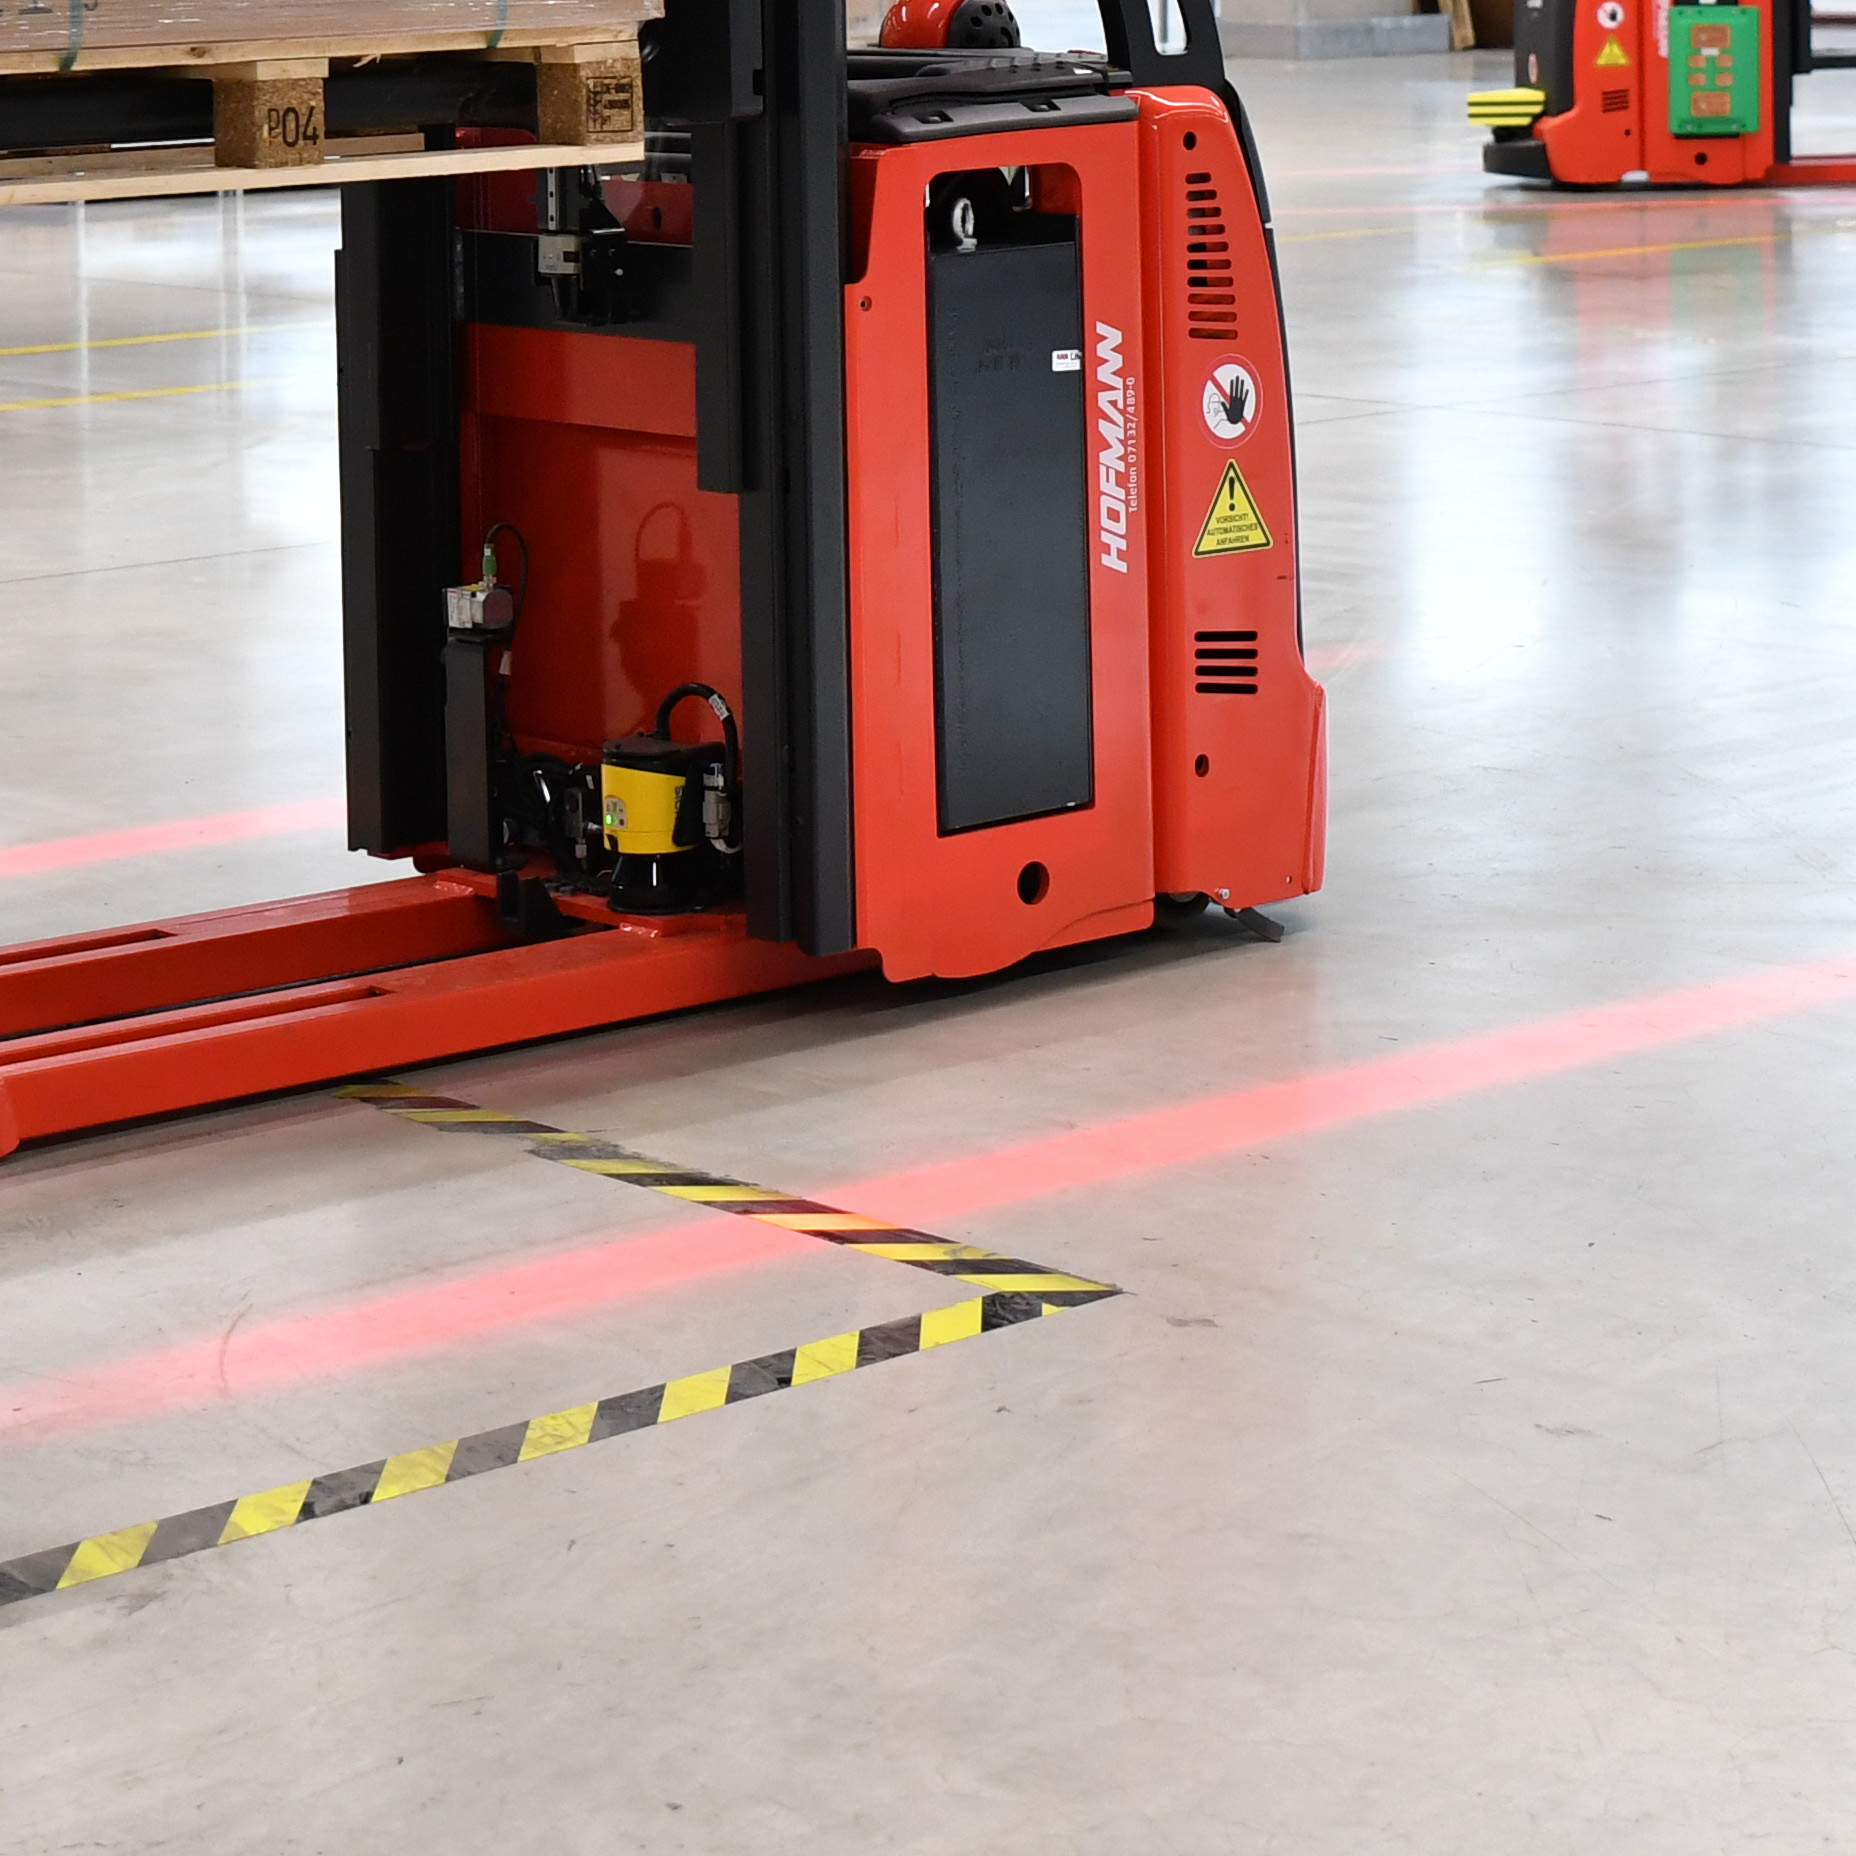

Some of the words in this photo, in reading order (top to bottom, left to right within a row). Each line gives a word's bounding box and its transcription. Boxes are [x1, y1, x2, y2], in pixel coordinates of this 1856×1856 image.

[1095, 320, 1128, 574] HOFMANN
[1128, 466, 1138, 513] Telefon
[1207, 522, 1258, 536] AUTOMATISCHES
[1216, 535, 1250, 545] ANFAHREN
